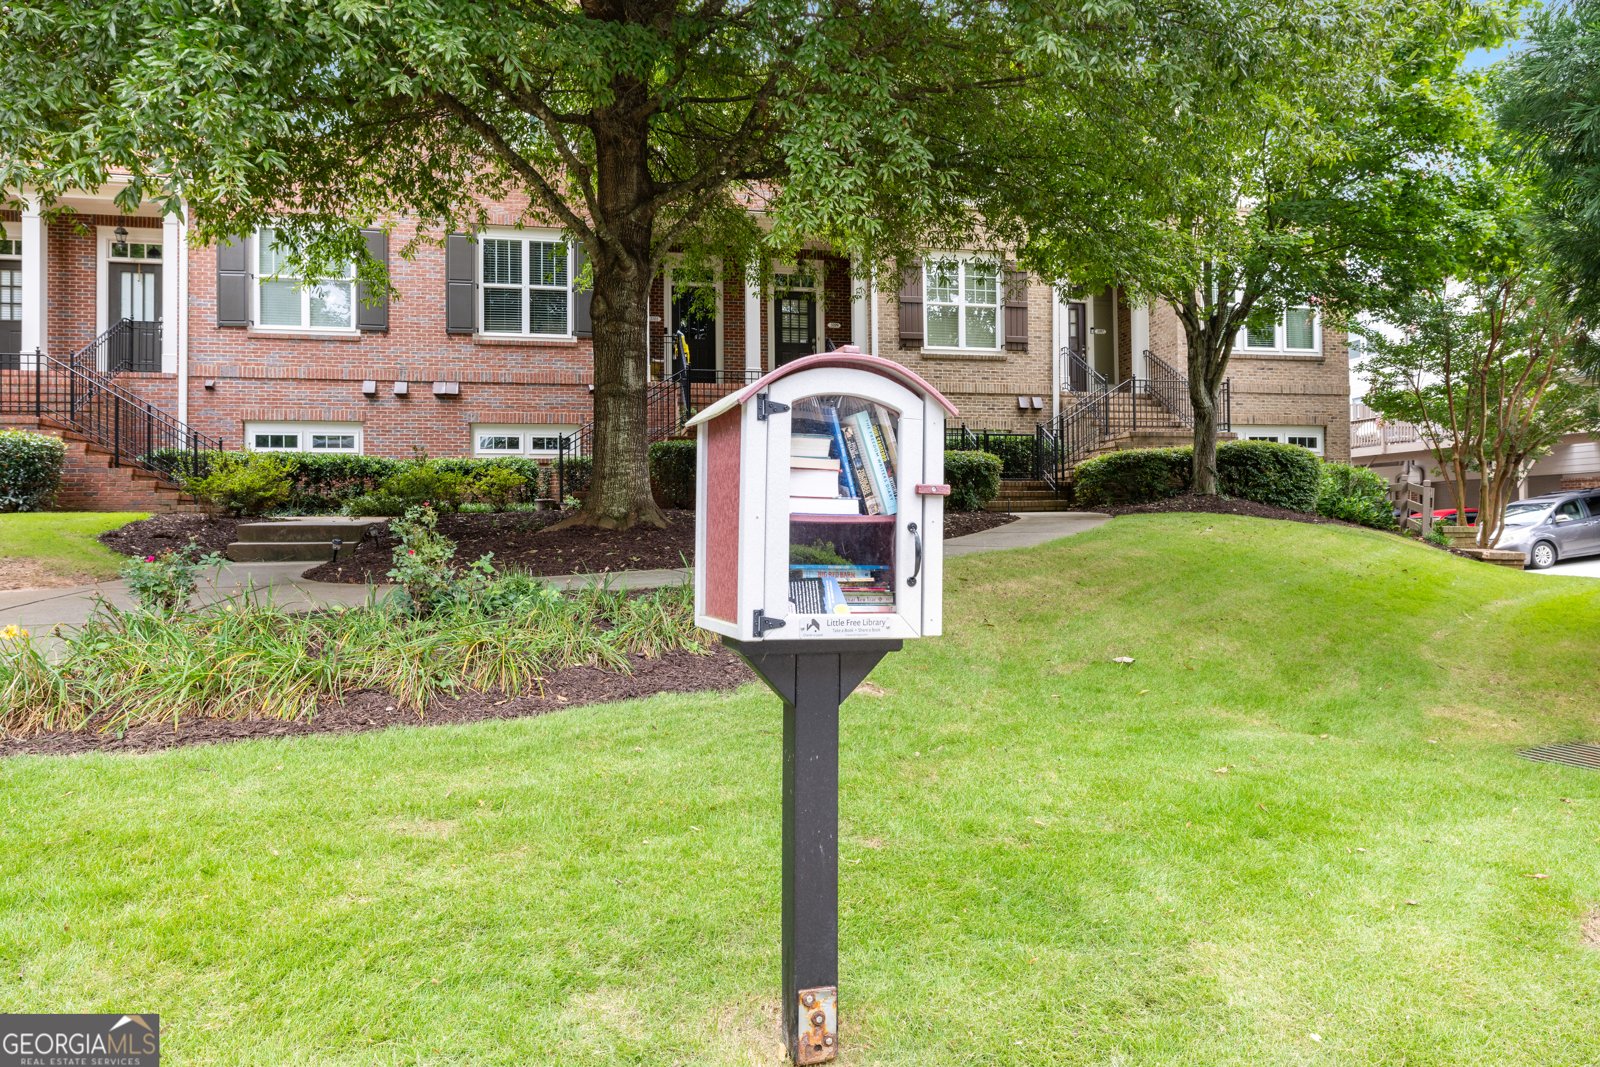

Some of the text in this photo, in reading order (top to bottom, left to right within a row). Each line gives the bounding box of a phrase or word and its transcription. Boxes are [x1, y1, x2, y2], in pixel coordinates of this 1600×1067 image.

[868, 431, 880, 457] FREEDOM
[877, 458, 888, 483] WRITERS
[885, 483, 894, 501] DIARY
[826, 619, 845, 627] Little
[862, 619, 886, 628] Library
